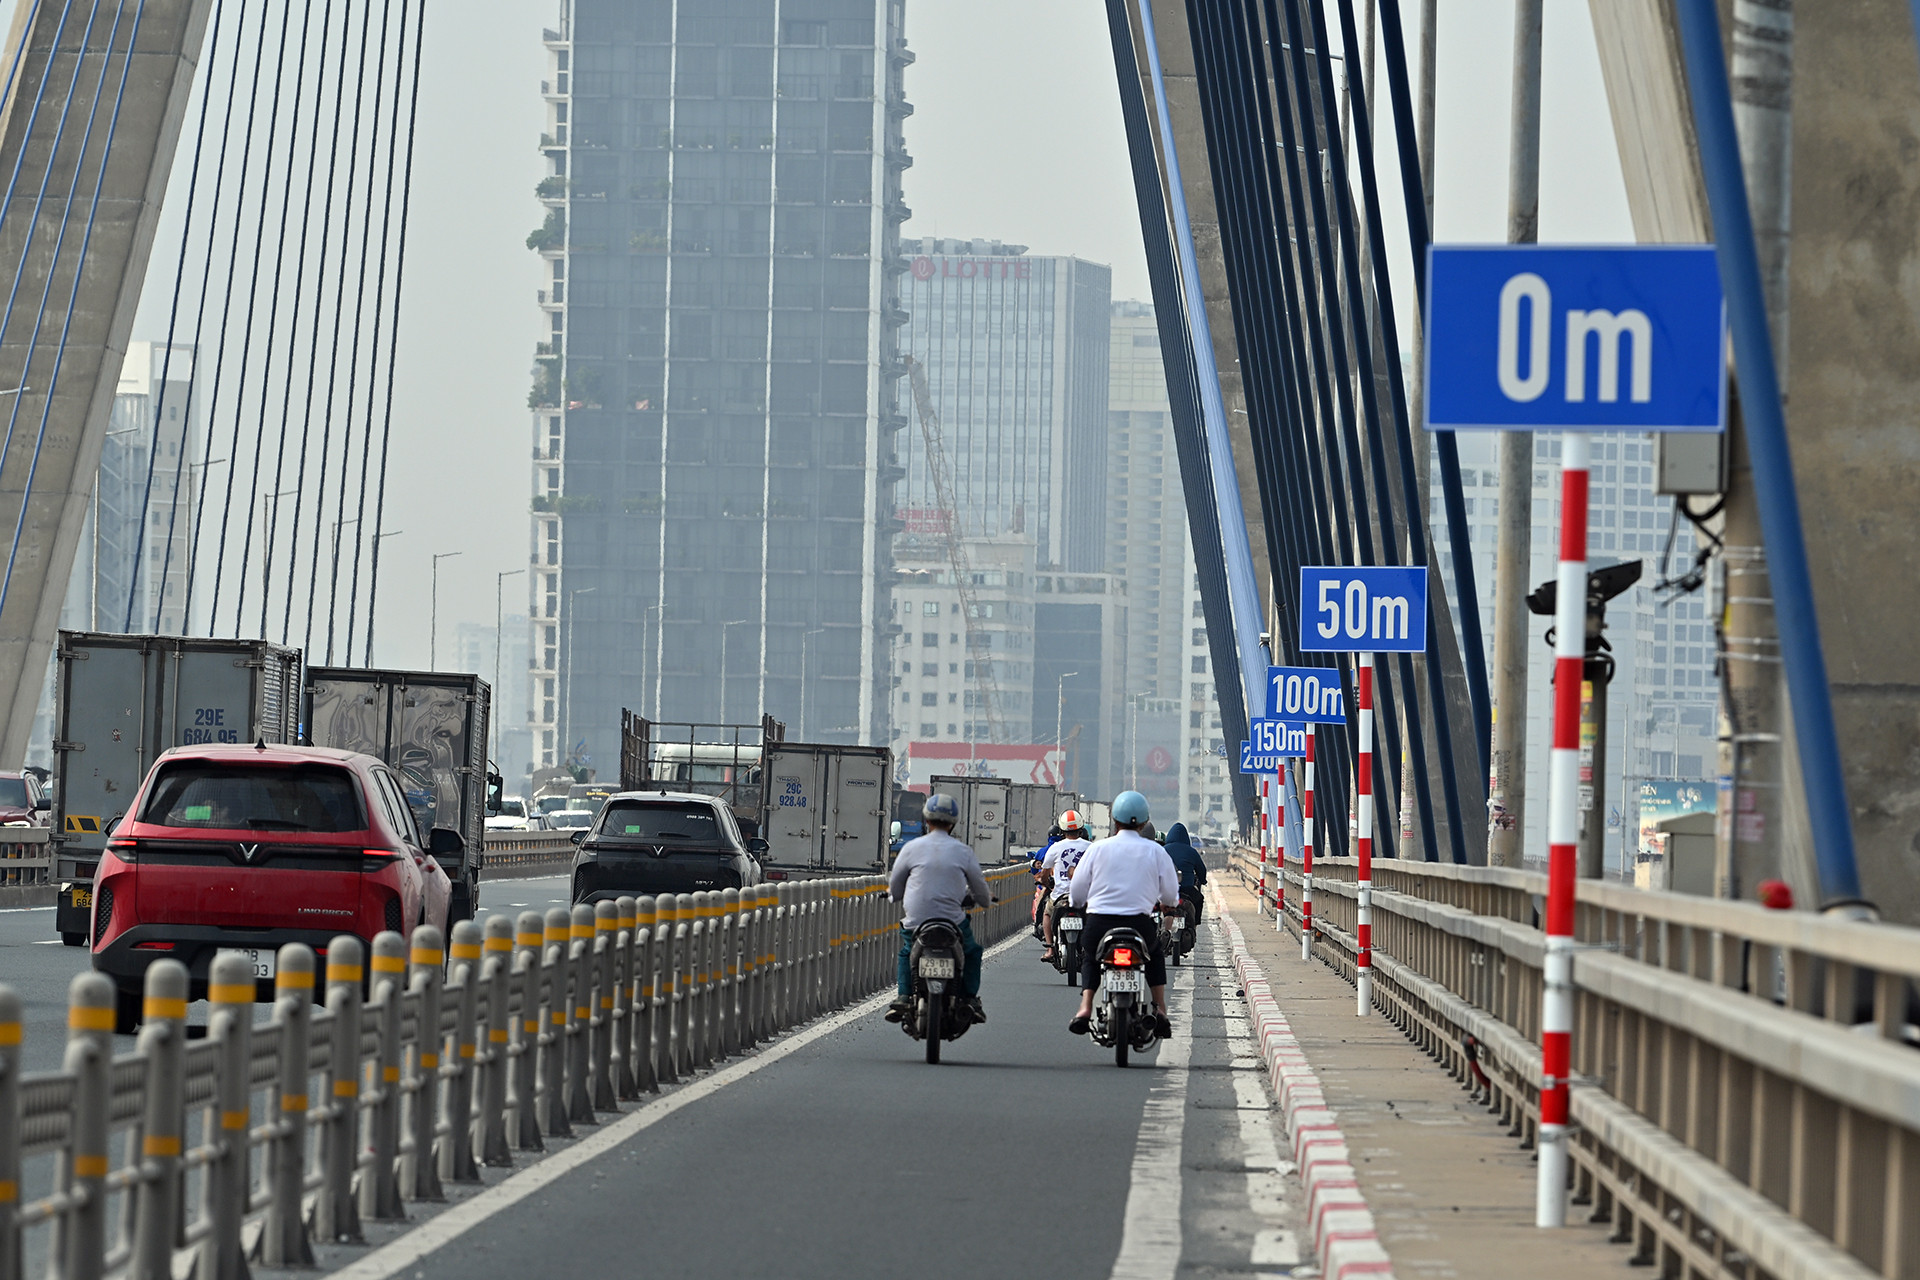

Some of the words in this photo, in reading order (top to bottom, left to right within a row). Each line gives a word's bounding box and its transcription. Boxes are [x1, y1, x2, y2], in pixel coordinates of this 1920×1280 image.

[942, 259, 1031, 279] LOTTE
[1498, 272, 1652, 403] 0m
[1317, 579, 1409, 640] 50m
[1272, 674, 1346, 717] 100m
[194, 708, 225, 726] 29E
[1253, 722, 1306, 752] 150m
[779, 795, 807, 807] 928.48
[786, 783, 802, 794] 29C
